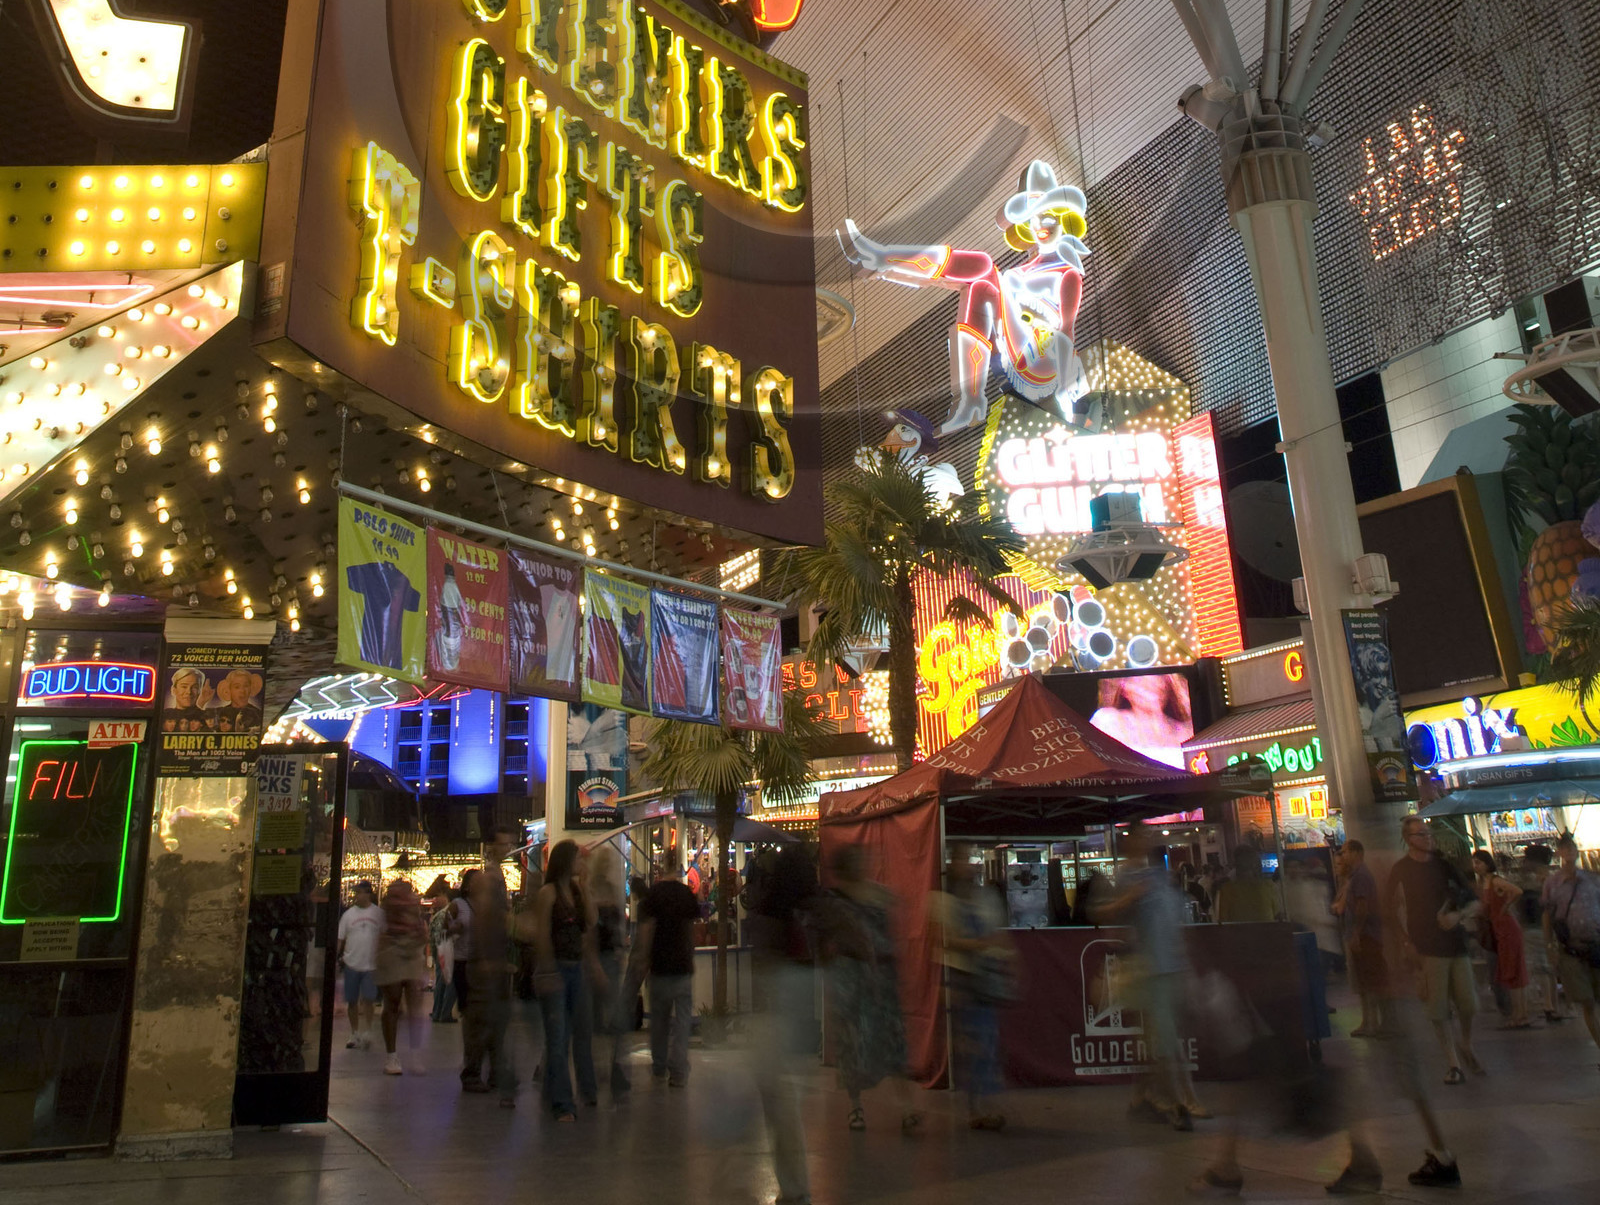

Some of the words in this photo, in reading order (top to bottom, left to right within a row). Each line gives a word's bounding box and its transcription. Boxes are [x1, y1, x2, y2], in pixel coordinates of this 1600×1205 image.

[446, 37, 706, 319] GIFTS
[352, 140, 795, 503] T-SHIRTS
[997, 430, 1173, 486] GLITTER
[354, 507, 389, 535] POLO
[390, 523, 416, 547] SHIRT
[438, 536, 500, 573] WATER
[465, 571, 474, 582] 12
[474, 573, 488, 585] OZ.
[518, 557, 553, 579] JUNIOR
[554, 567, 573, 583] TOP
[464, 596, 477, 613] 39
[478, 600, 505, 621] CENTS
[655, 592, 681, 611] MEN'S
[682, 599, 712, 618] SHIRTS
[470, 625, 487, 641] FOR
[216, 655, 234, 663] PER
[234, 655, 262, 663] HOUR!
[28, 667, 81, 696] BUD
[84, 666, 150, 695] LIGHT
[92, 723, 141, 739] ATM
[163, 735, 204, 750] LARRY
[206, 735, 218, 750] G.
[219, 735, 258, 750] JONES
[992, 743, 1085, 779] FROZEN
[1227, 736, 1323, 773] BWOUT
[1066, 778, 1105, 788] SHOTS
[1477, 773, 1503, 782] ASIAN
[1504, 769, 1534, 780] GIFTS
[1261, 859, 1279, 868] PEPS
